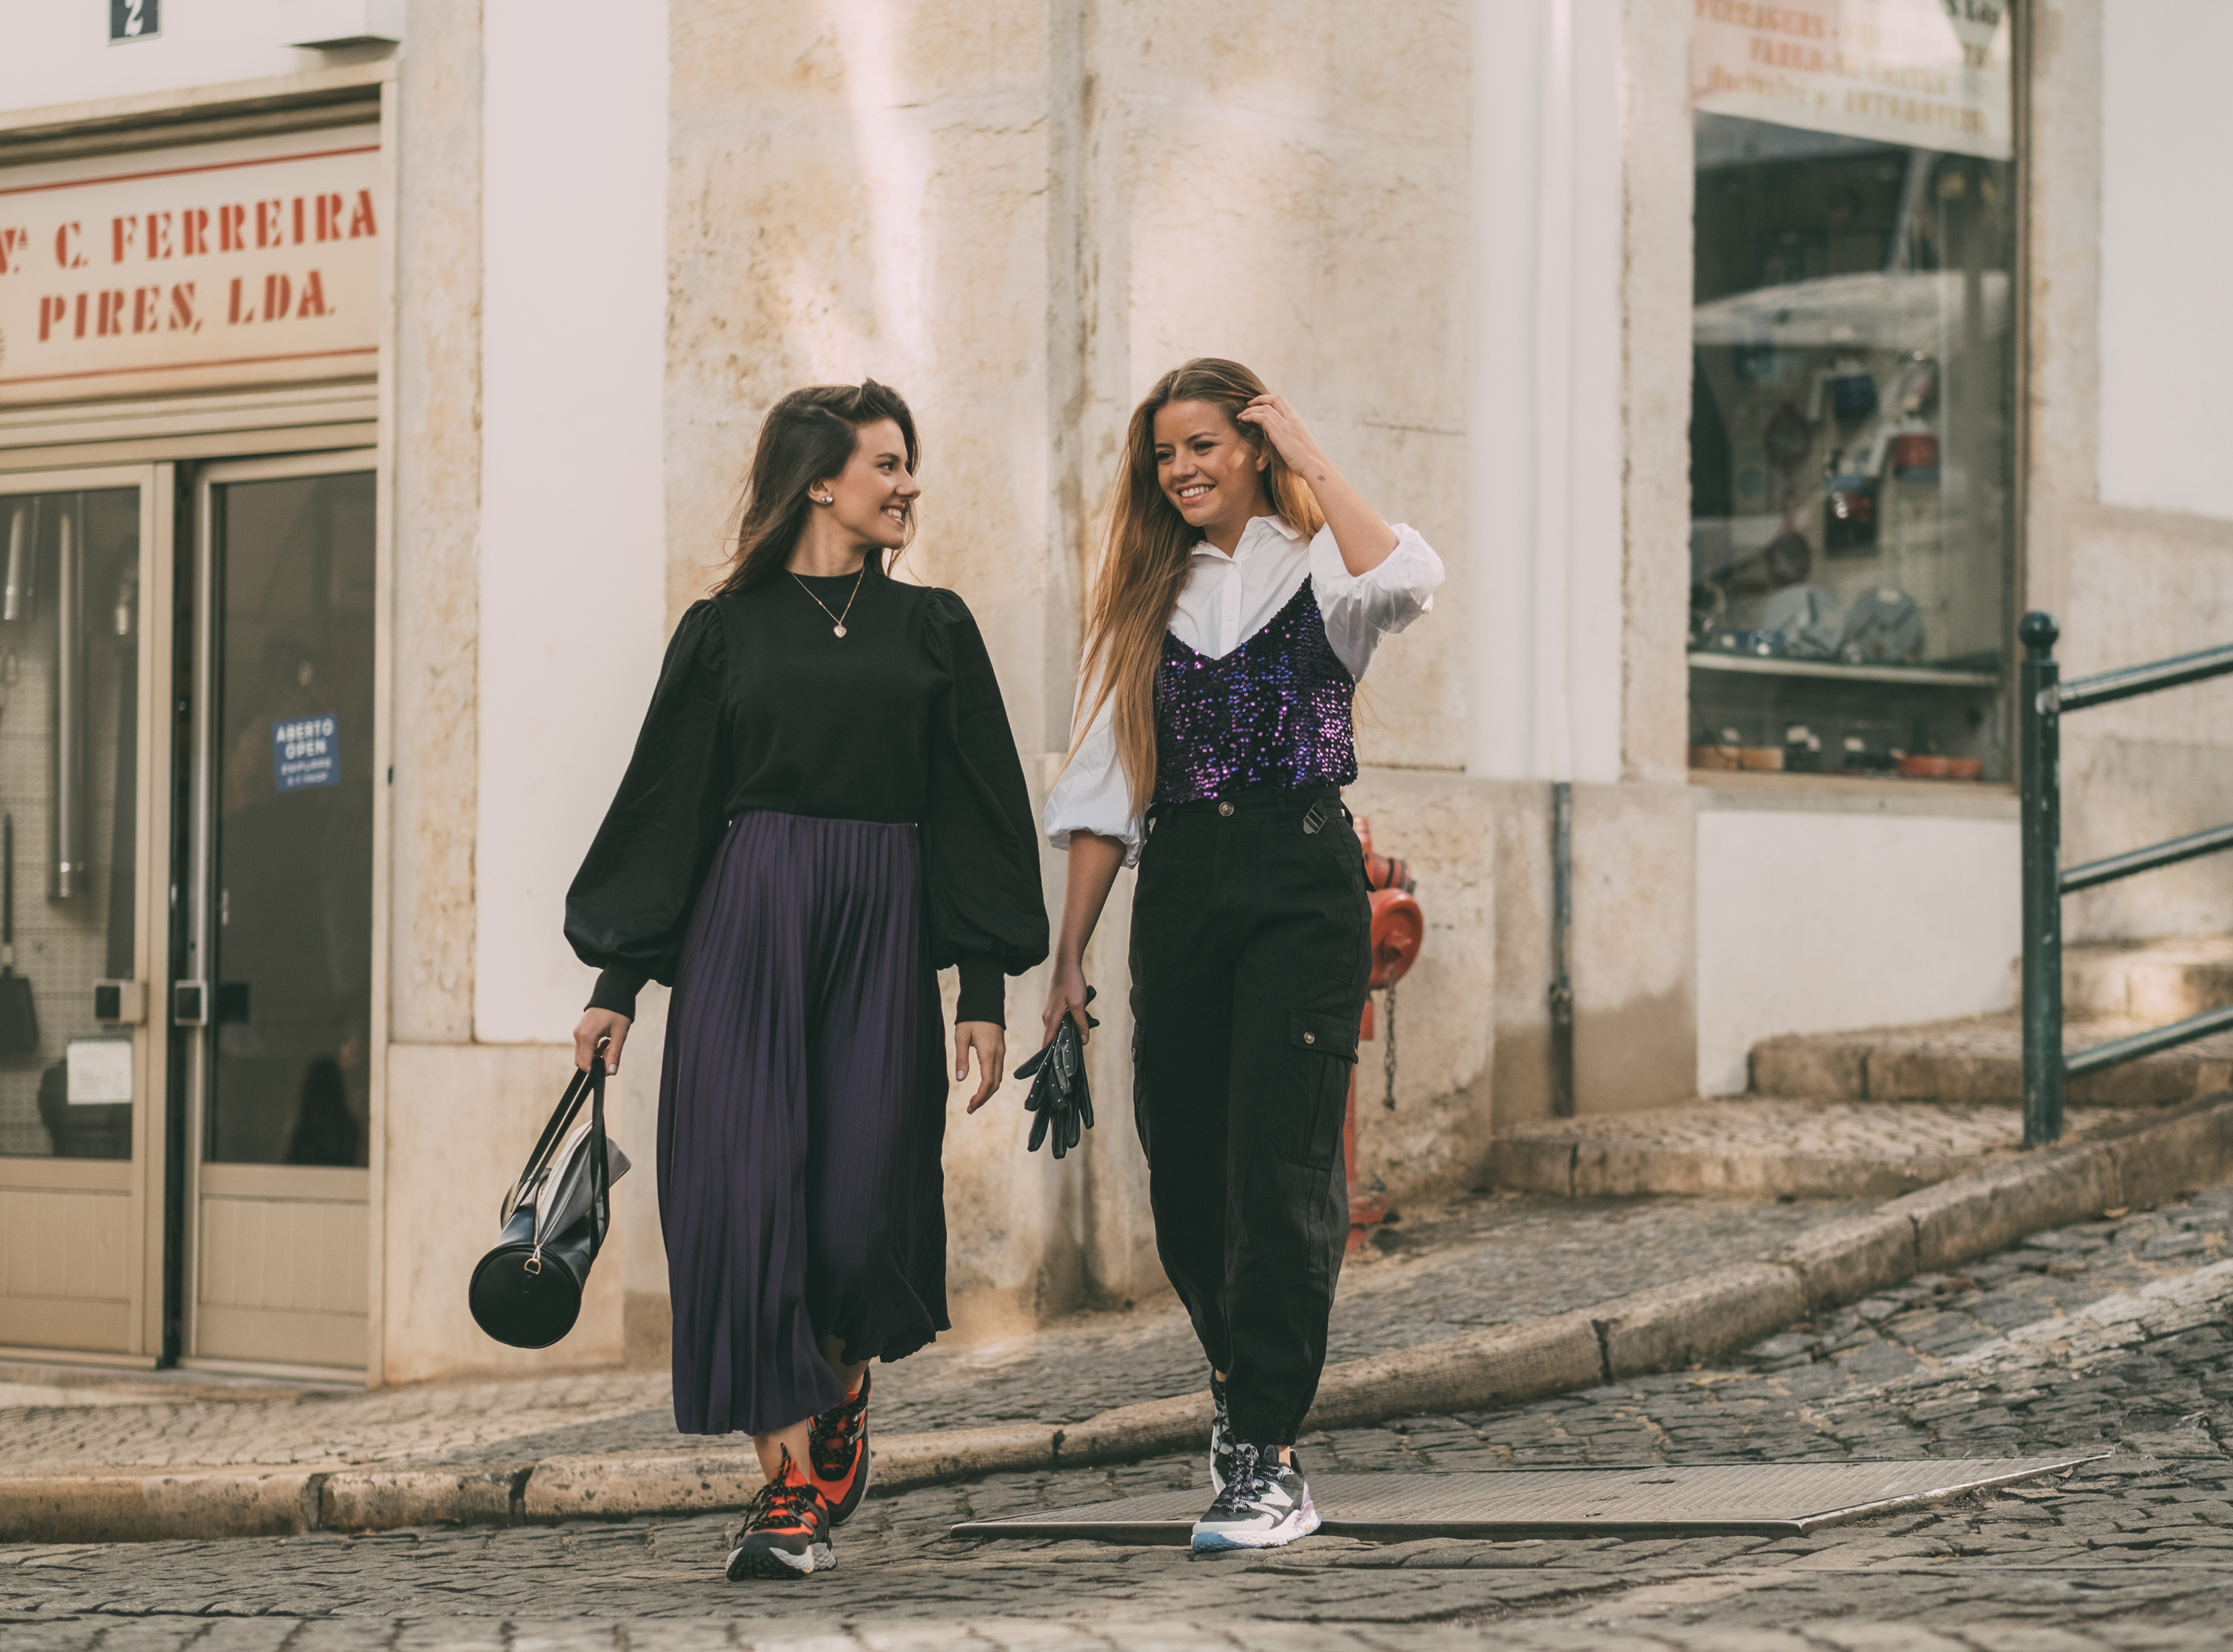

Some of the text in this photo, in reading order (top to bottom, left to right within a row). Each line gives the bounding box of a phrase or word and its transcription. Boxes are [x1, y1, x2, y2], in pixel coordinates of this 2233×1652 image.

[124, 0, 144, 36] 2
[54, 222, 89, 269] C.
[112, 189, 377, 265] FERREIRA
[38, 269, 336, 342] PIRES, LDA.
[276, 718, 334, 743] ABERTO
[285, 738, 328, 760] OPEN
